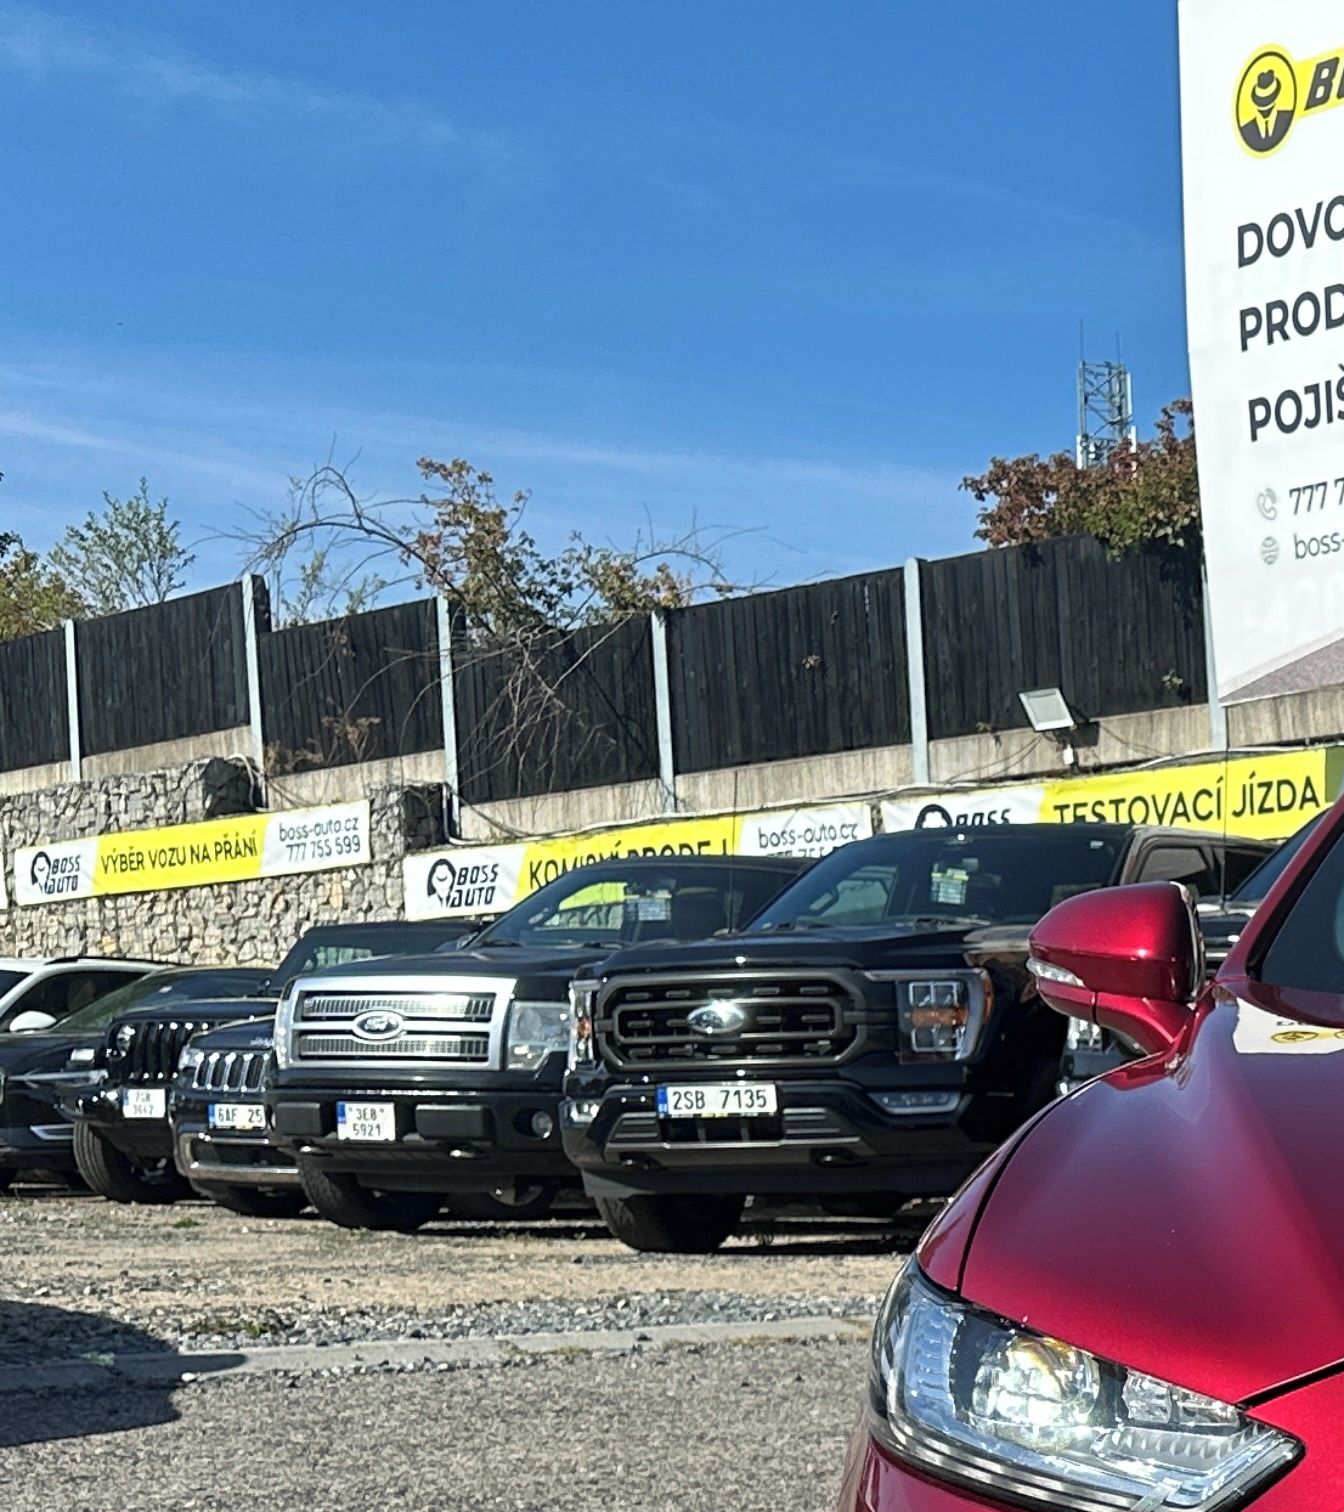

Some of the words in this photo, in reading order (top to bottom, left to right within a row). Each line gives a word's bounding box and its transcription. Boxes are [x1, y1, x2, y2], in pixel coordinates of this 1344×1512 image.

[1289, 480, 1329, 514] 777
[1053, 775, 1223, 826] TESTOVACÍ
[1232, 770, 1322, 818] JÍZDA
[279, 817, 359, 842] boss-auto.cz
[758, 823, 859, 848] boss-auto.cz
[101, 846, 145, 874] VÝBĚR
[148, 847, 186, 868] VOZU
[189, 844, 211, 863] NA
[213, 830, 258, 860] PŘÁNÍ
[286, 842, 307, 862] 777
[310, 838, 332, 859] 755
[335, 834, 361, 855] 599
[51, 855, 81, 875] BOSS
[458, 862, 499, 886] BOSS
[48, 874, 79, 894] AUTO
[452, 886, 496, 908] AUTO
[672, 1090, 705, 1110] 2SB
[719, 1089, 767, 1108] 7135
